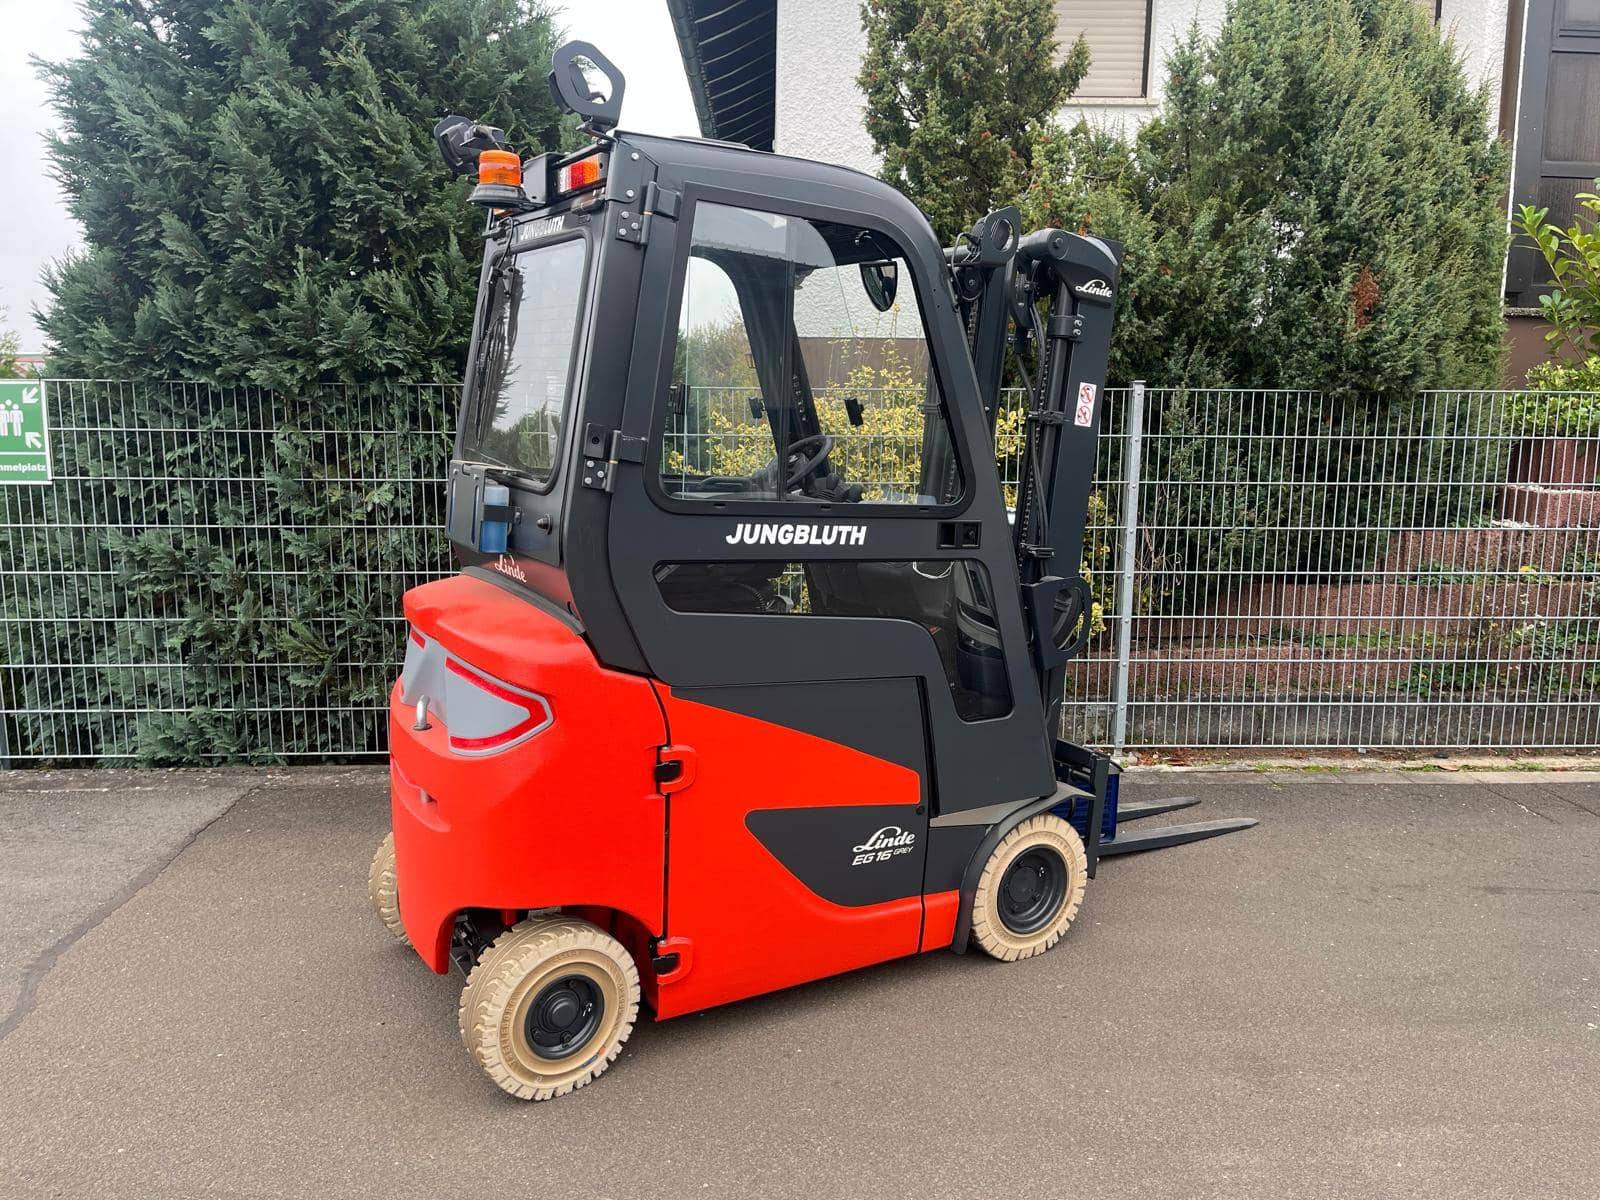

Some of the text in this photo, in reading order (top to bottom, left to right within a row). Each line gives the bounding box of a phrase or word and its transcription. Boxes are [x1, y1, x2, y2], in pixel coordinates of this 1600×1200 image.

[1075, 279, 1114, 298] Linde
[725, 523, 867, 546] JUNGBLUTH
[494, 554, 527, 583] Linde
[852, 826, 916, 853] Linde
[852, 853, 876, 866] EG
